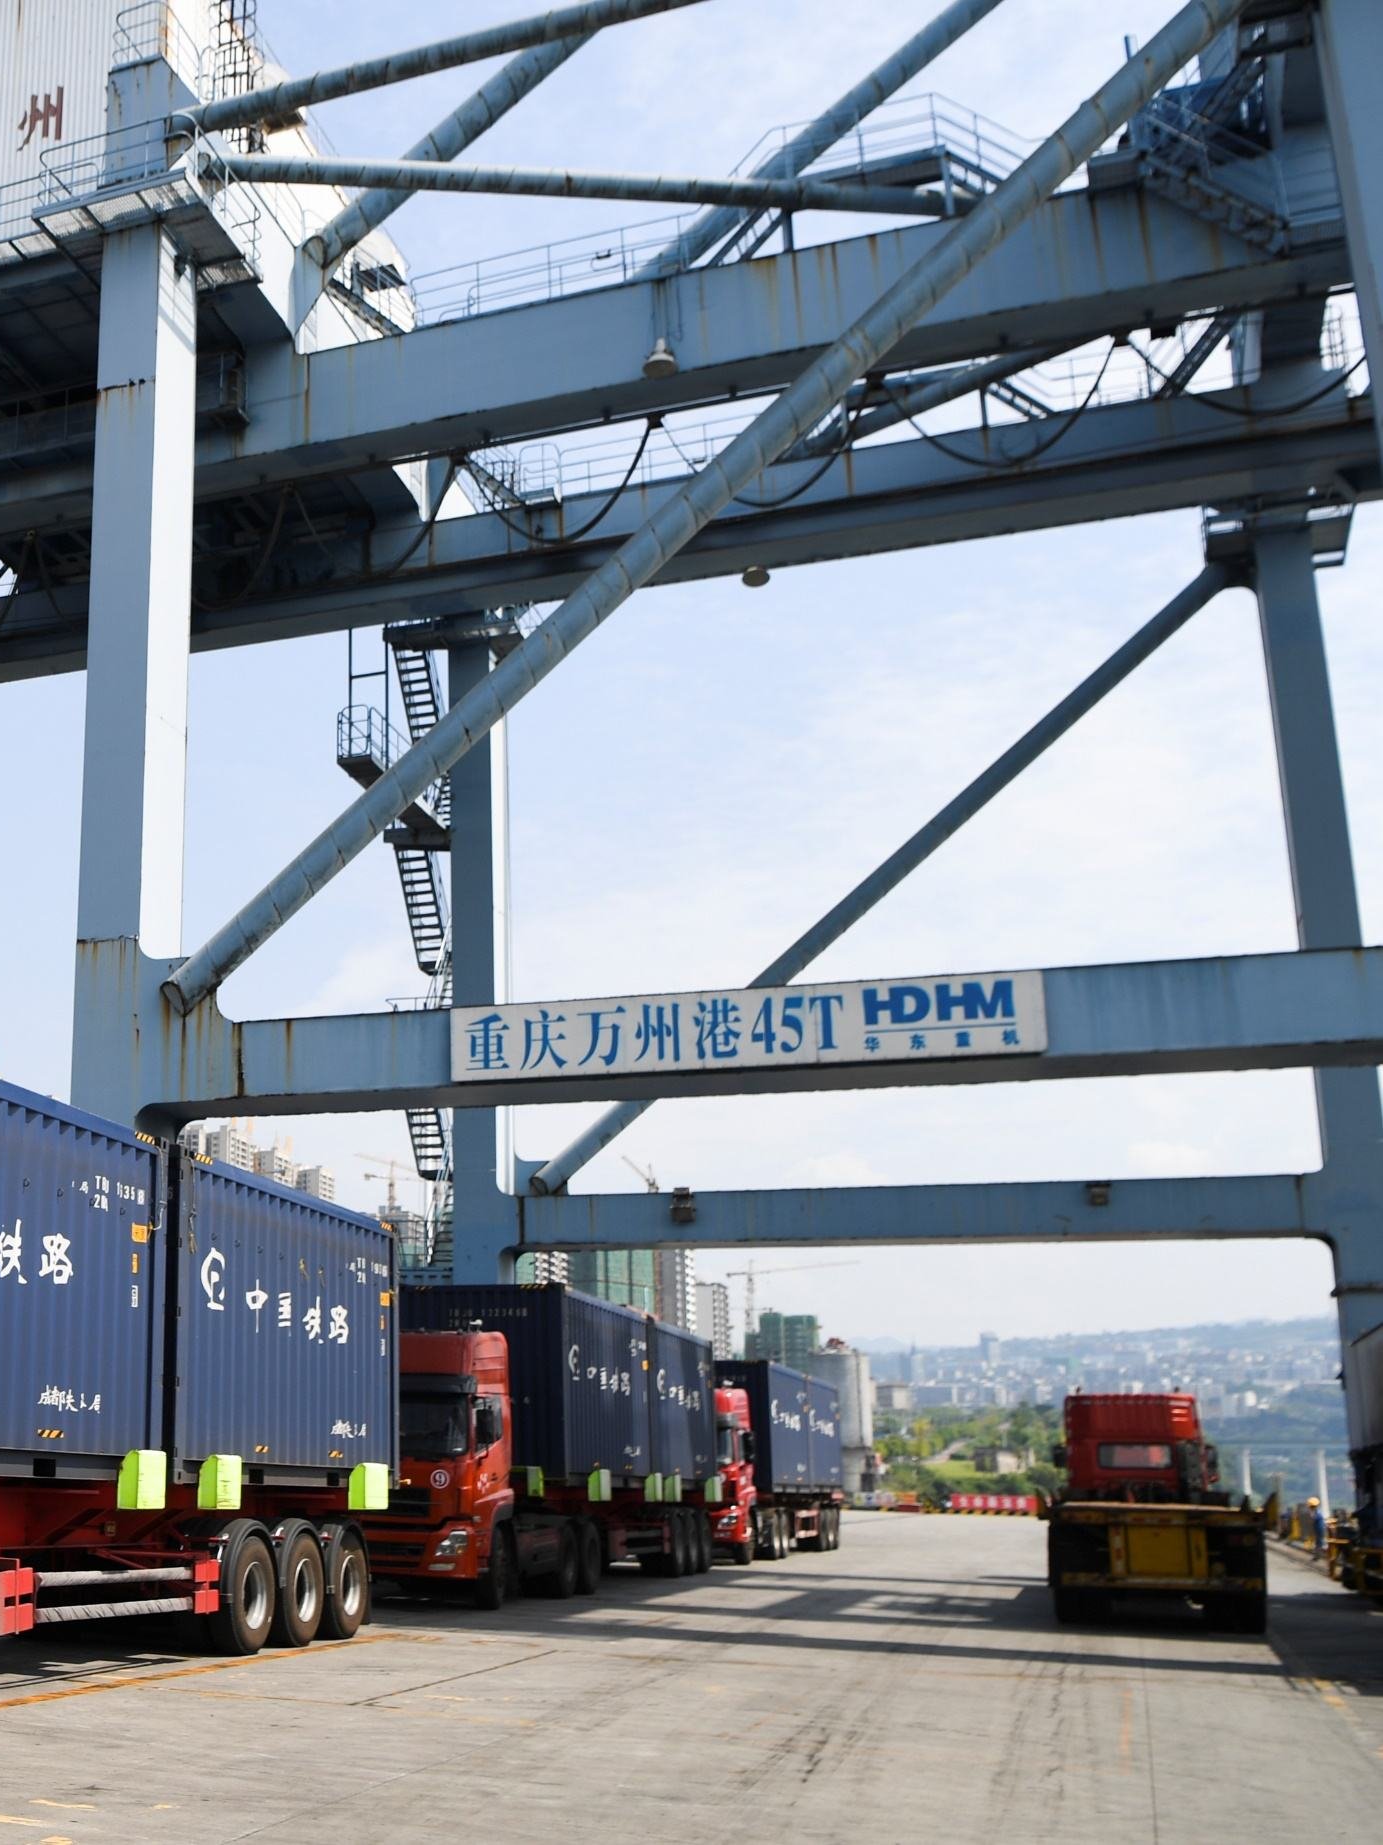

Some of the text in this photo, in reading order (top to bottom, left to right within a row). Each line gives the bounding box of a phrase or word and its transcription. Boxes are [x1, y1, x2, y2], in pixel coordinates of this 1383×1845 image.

[863, 979, 1016, 1026] HDHM
[864, 1029, 1020, 1054] 华东重机
[245, 1278, 349, 1344] 中国铁路
